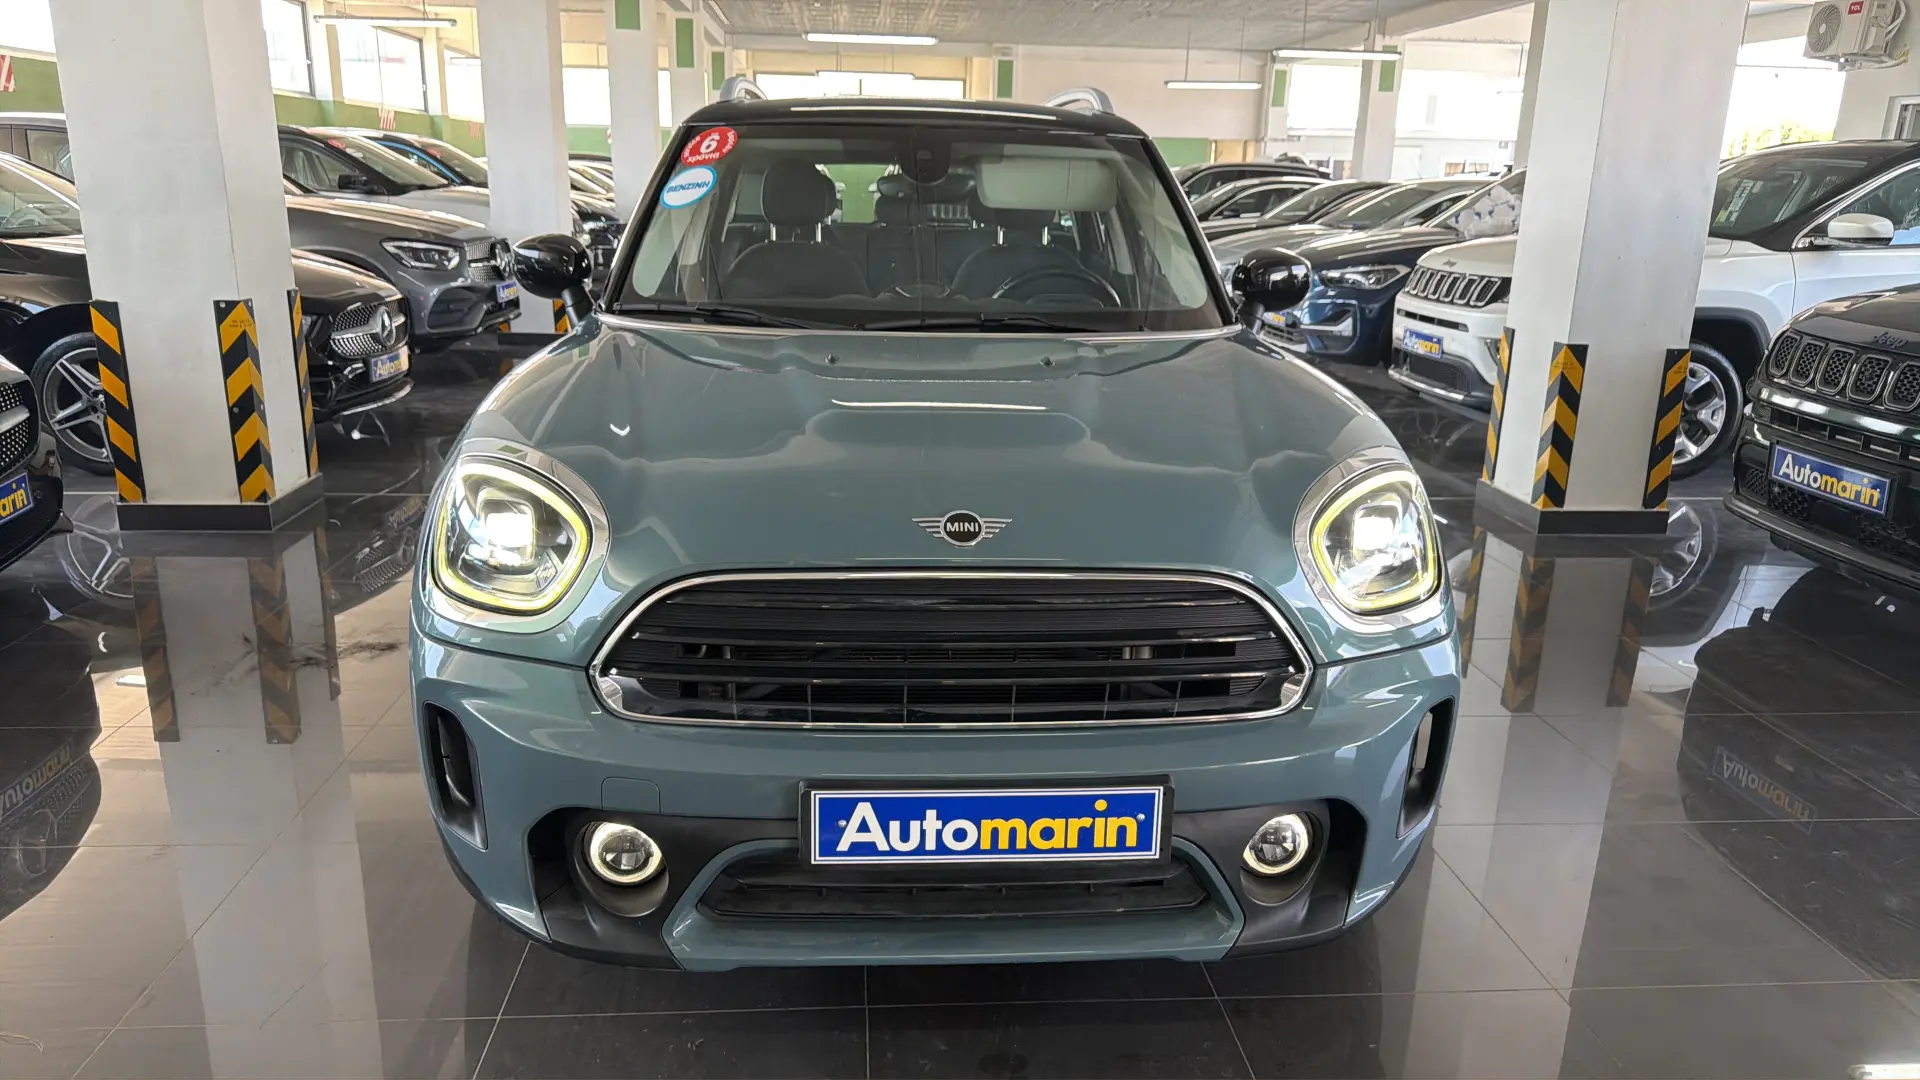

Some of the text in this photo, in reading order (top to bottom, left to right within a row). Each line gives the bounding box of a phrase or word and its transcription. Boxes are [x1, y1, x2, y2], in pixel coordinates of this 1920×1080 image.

[700, 134, 720, 154] 6
[1779, 453, 1880, 508] Automarin
[946, 521, 979, 532] MINI
[836, 799, 1138, 852] Automarin
